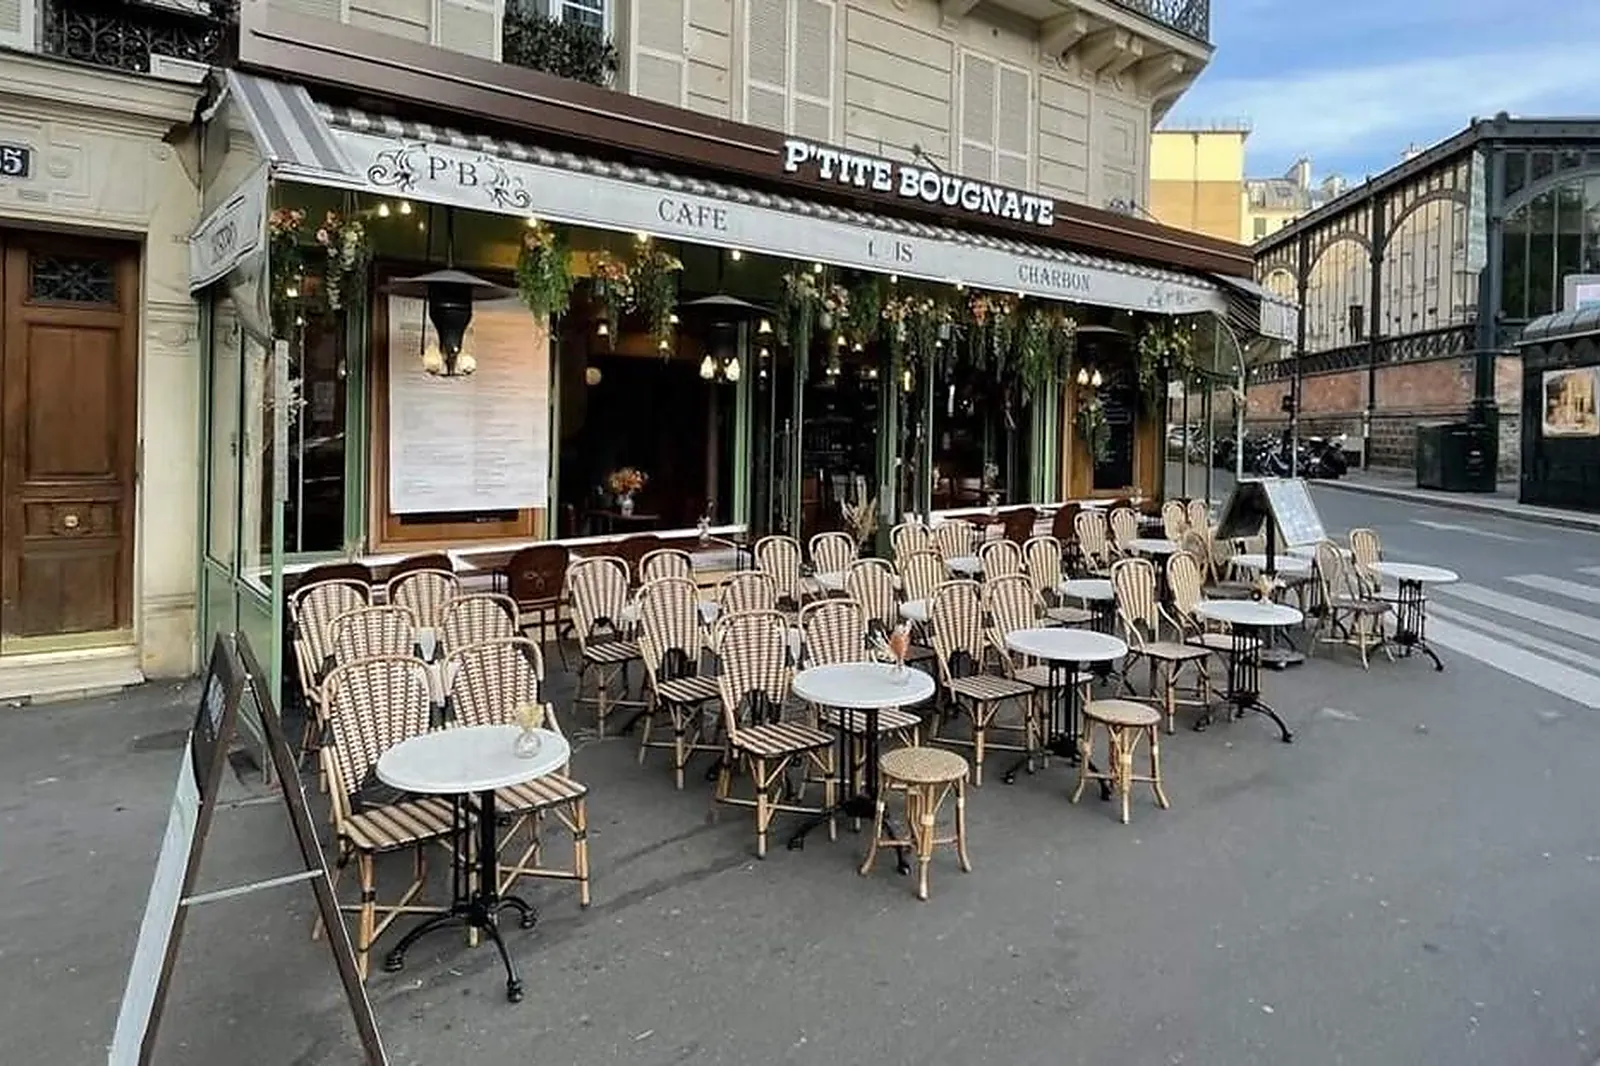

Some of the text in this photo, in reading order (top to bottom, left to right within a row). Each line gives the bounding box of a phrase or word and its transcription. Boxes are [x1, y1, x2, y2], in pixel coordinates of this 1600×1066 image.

[0, 148, 22, 173] 5
[784, 140, 1054, 226] P'TITE BOUGNATE
[657, 198, 728, 231] CAFE
